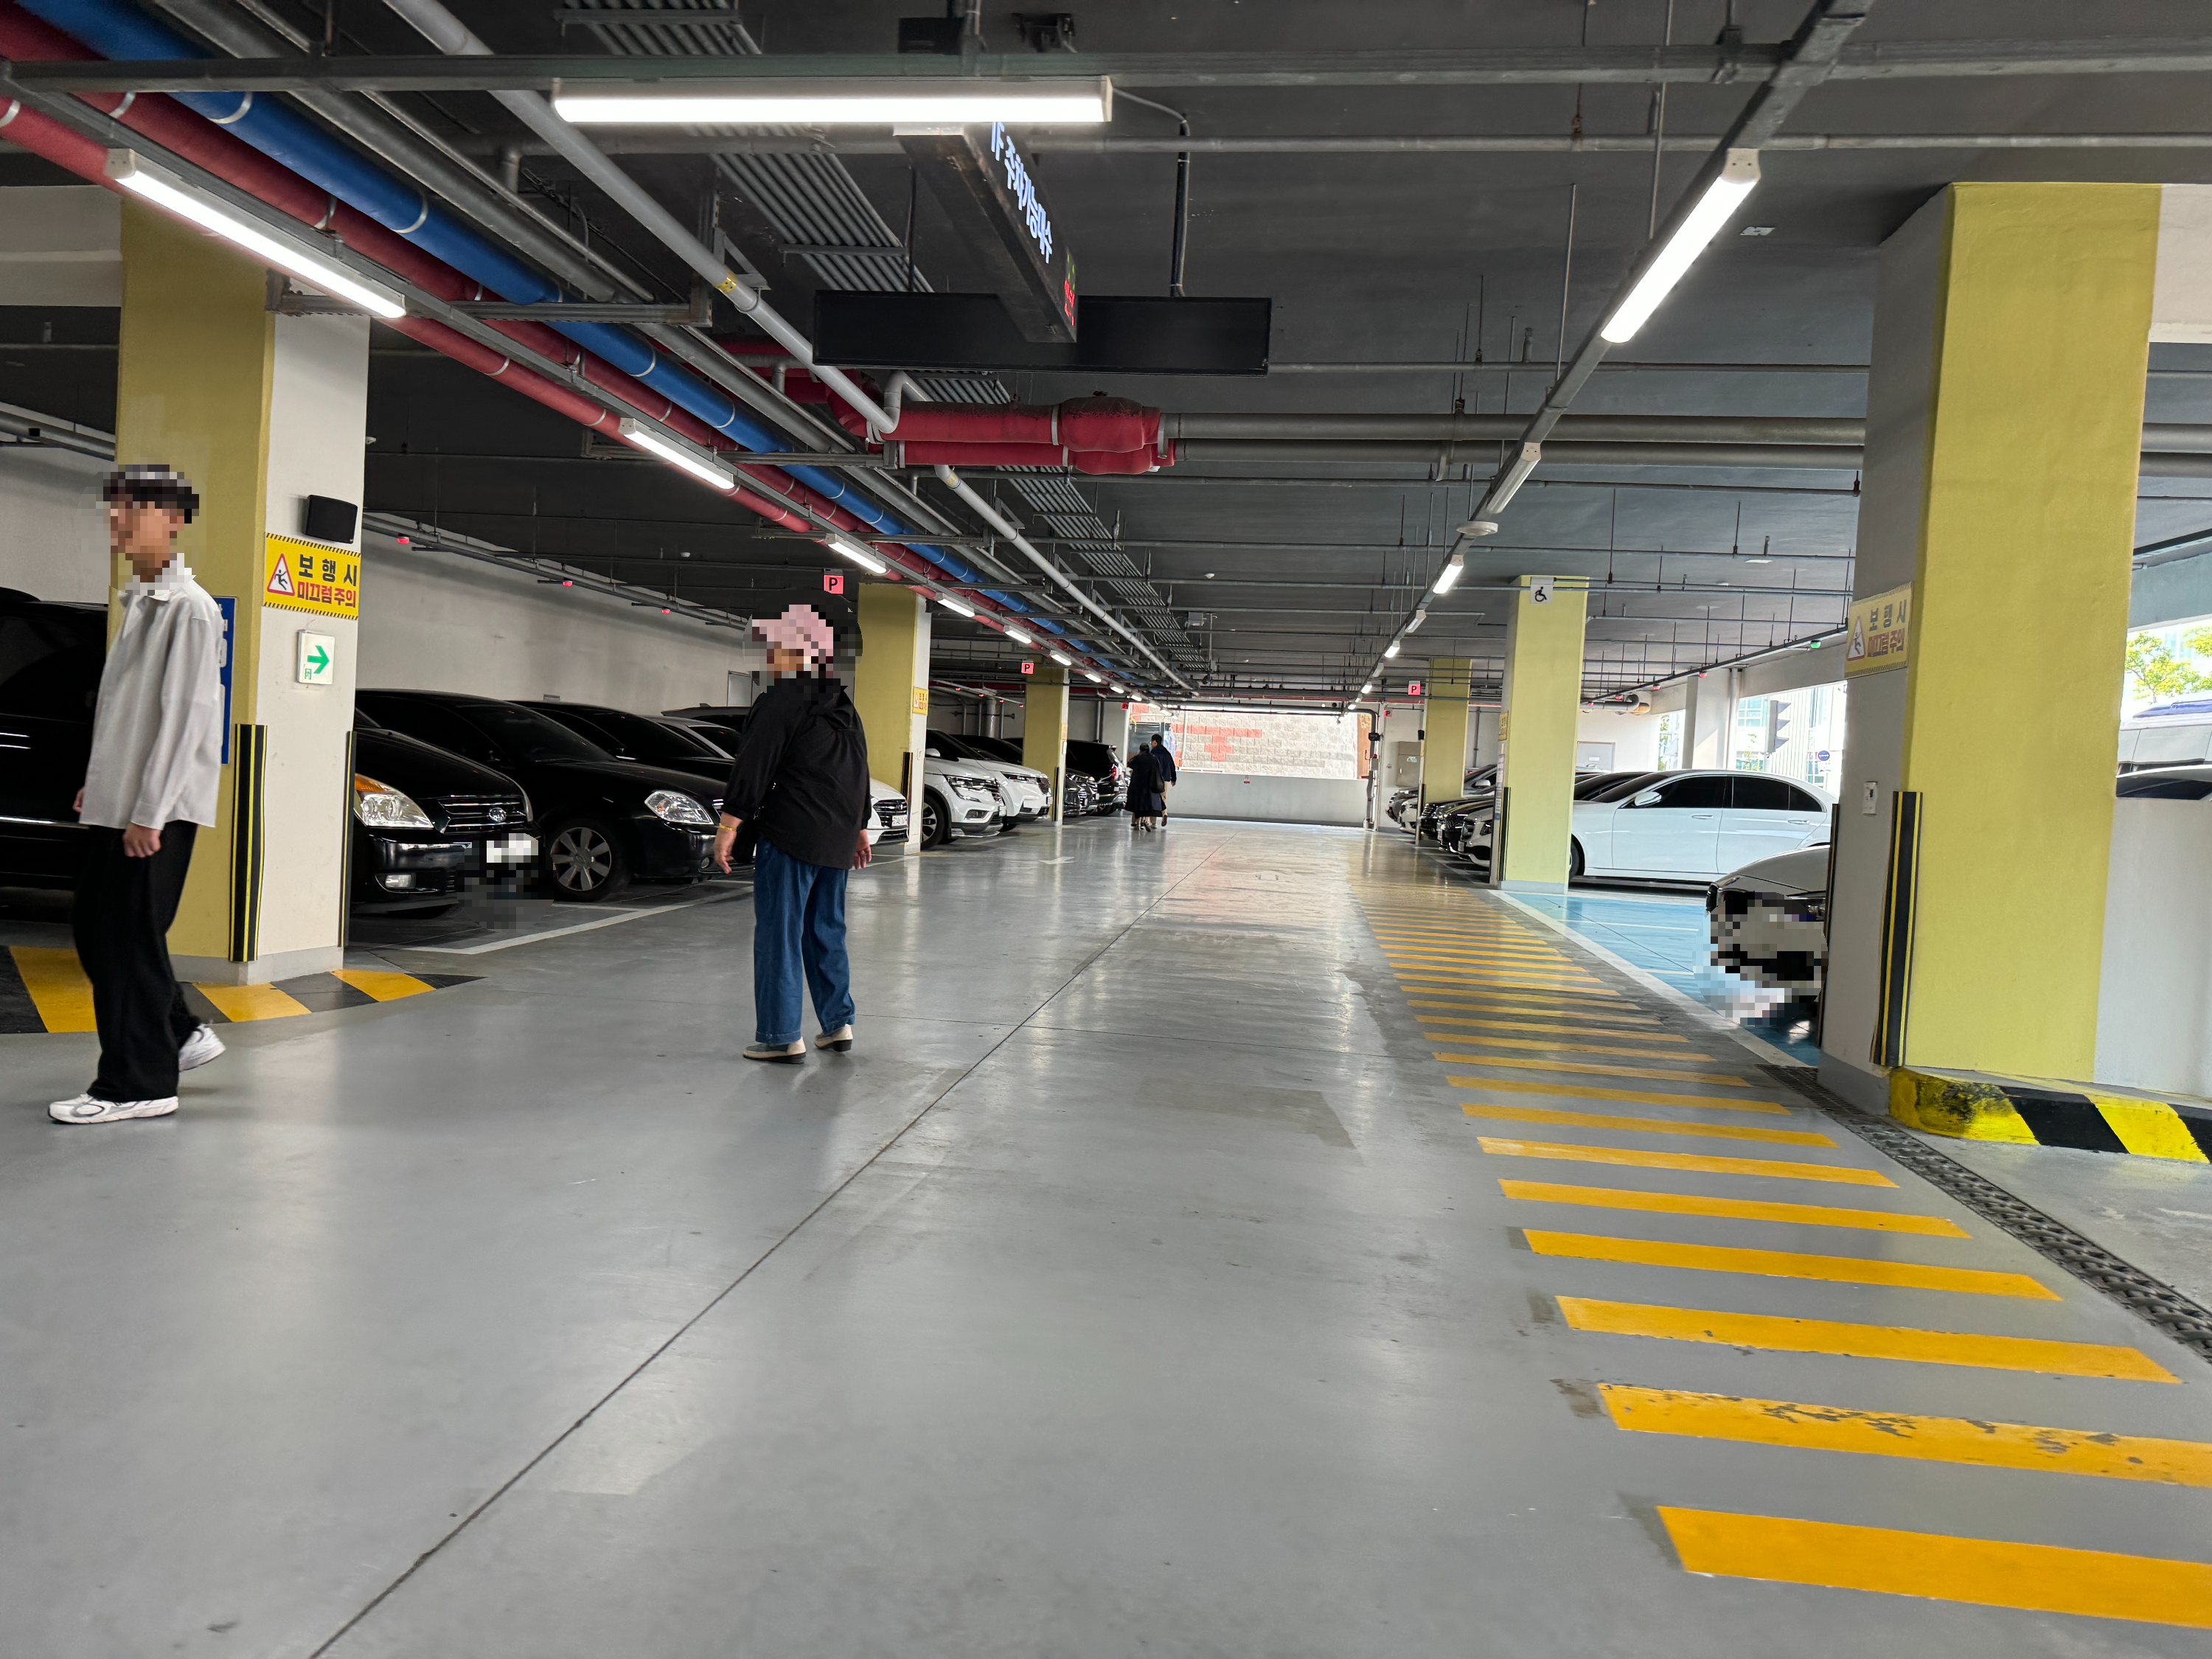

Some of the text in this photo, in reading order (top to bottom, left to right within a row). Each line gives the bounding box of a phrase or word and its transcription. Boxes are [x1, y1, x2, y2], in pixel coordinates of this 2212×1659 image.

[829, 577, 838, 591] P
[1024, 664, 1031, 672] P
[1411, 685, 1417, 693] P
